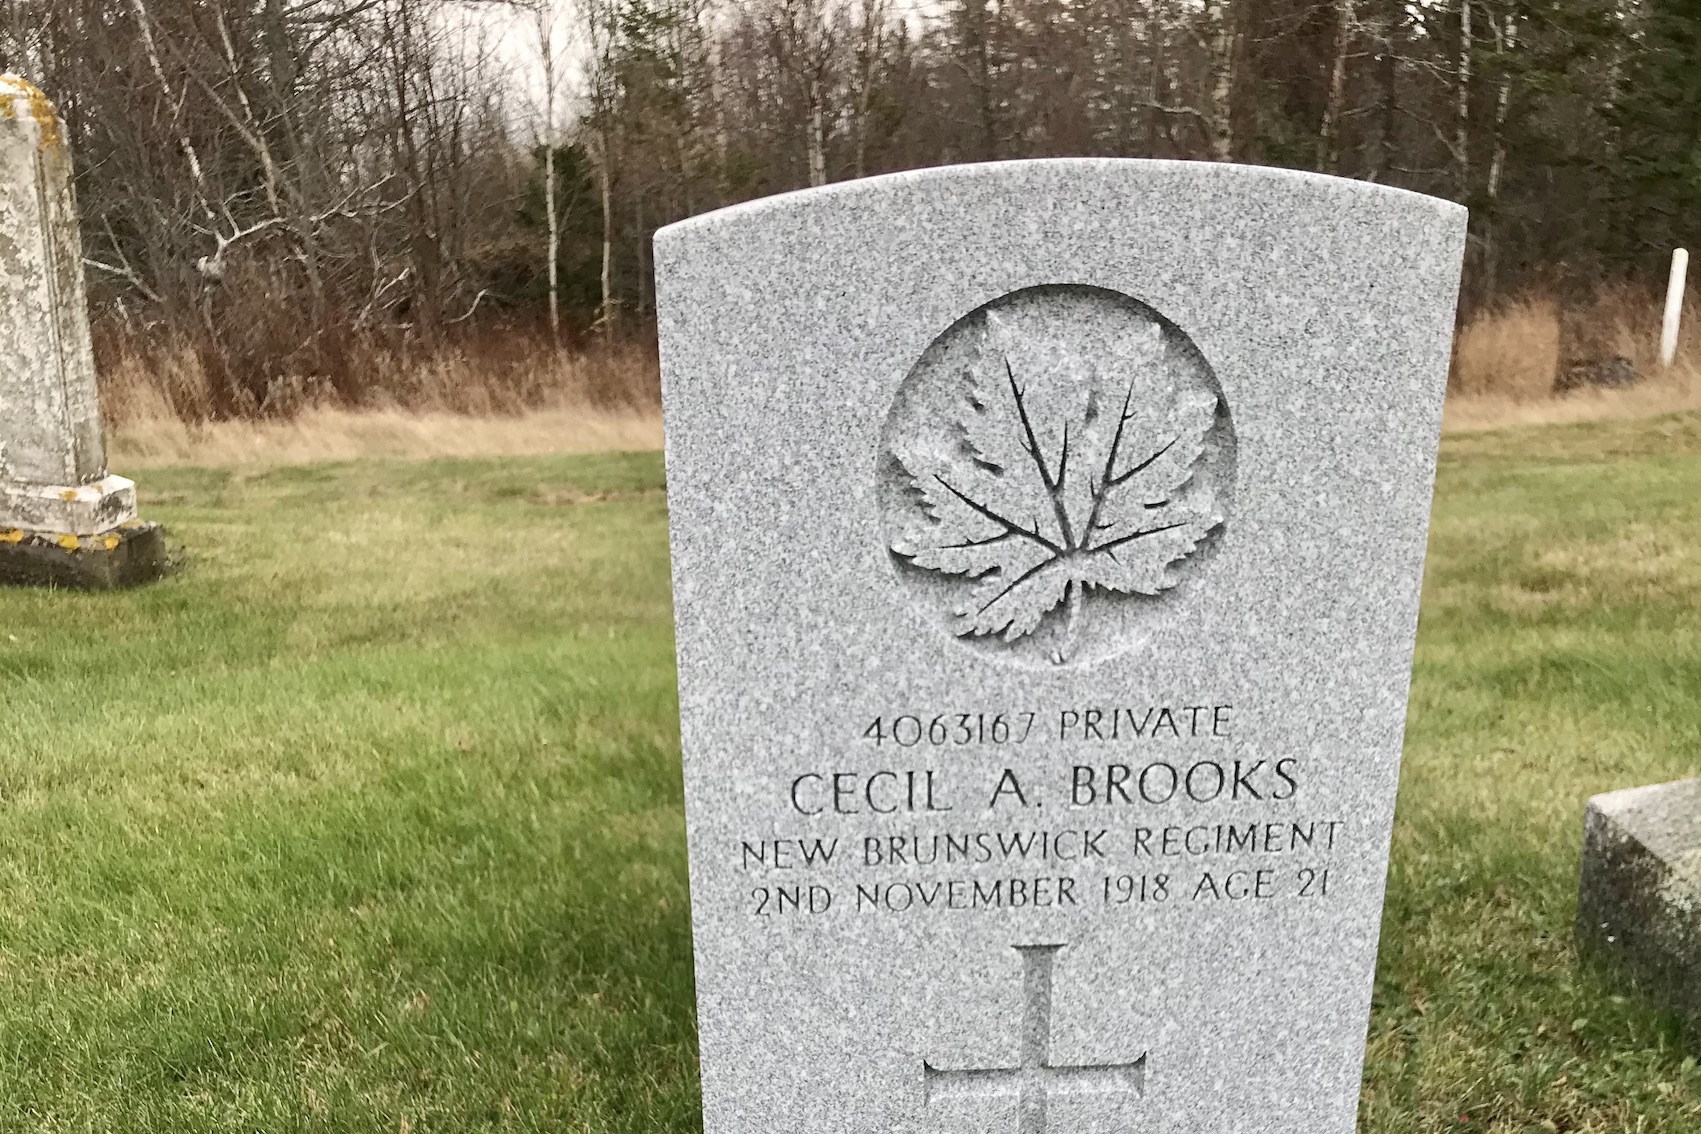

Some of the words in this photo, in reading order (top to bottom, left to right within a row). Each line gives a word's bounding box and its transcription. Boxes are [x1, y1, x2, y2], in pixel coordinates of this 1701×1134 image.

[863, 712, 1036, 748] 4063167
[1059, 704, 1234, 741] PRIVATE
[790, 769, 954, 816] CECIL
[988, 768, 1044, 808] A.
[1070, 756, 1300, 808] BROOKS
[740, 838, 840, 872] NEW
[863, 829, 1109, 867] BRUNSWICK
[1133, 820, 1345, 859] REGIMENT
[751, 885, 833, 917] 2ND
[855, 876, 1078, 914] NOVEMBER
[1102, 873, 1171, 904] 1918
[1191, 869, 1275, 902] AGE
[1297, 867, 1329, 898] 21
